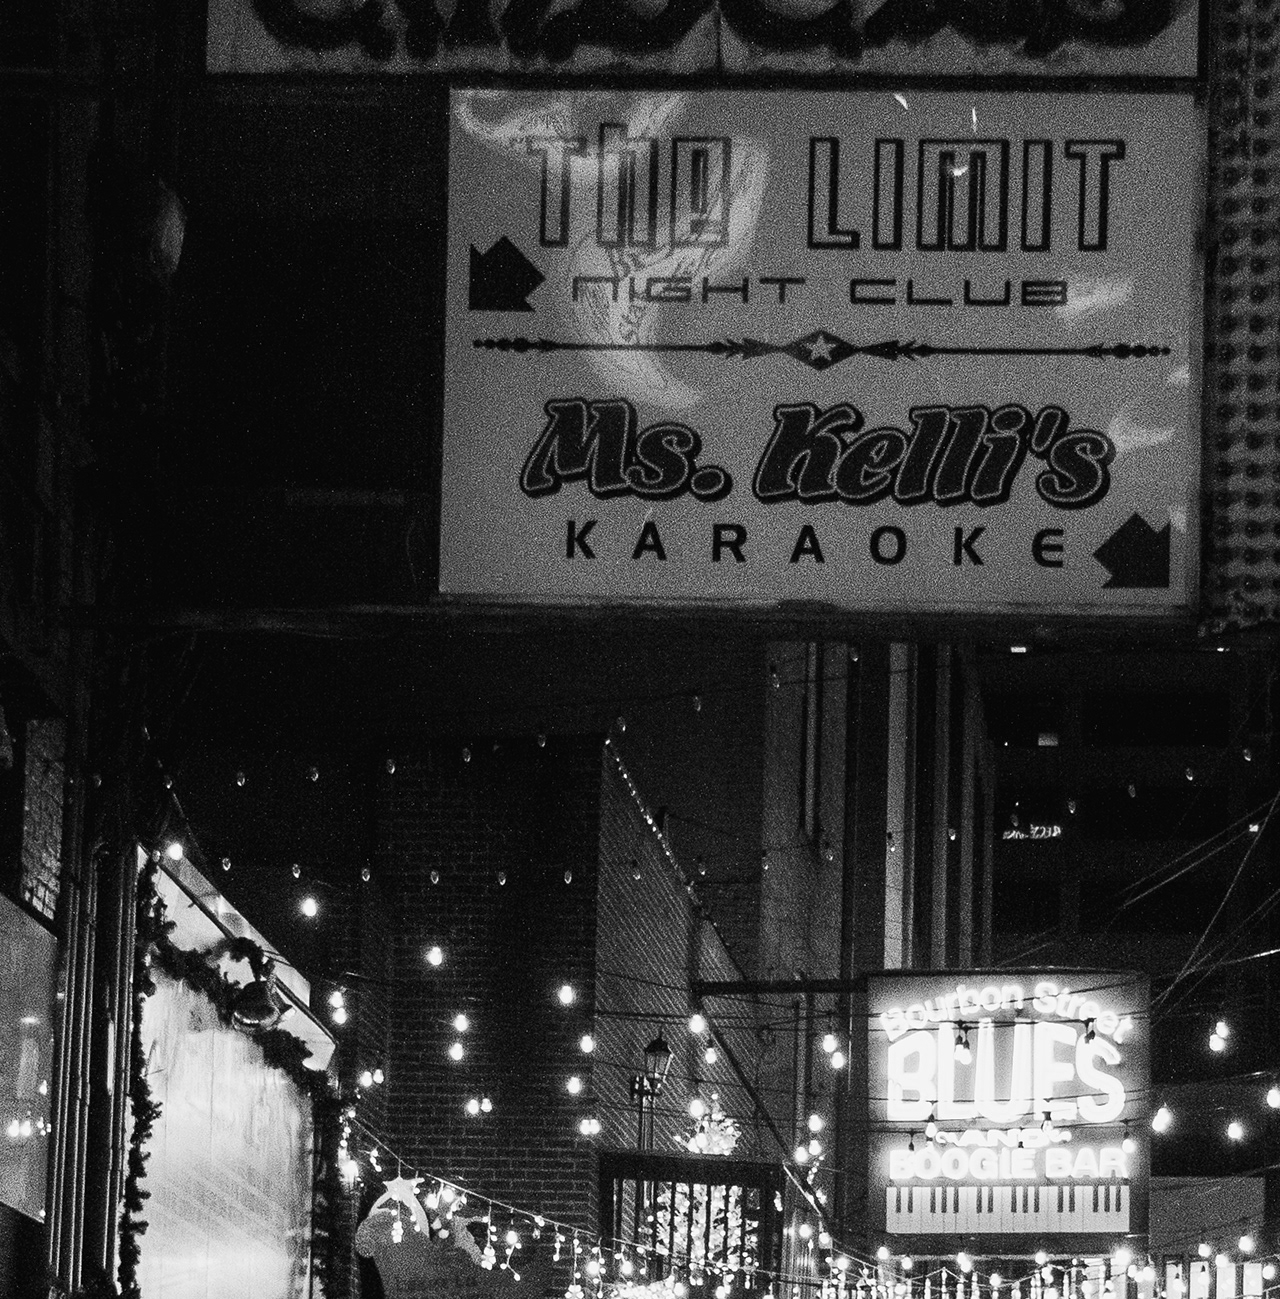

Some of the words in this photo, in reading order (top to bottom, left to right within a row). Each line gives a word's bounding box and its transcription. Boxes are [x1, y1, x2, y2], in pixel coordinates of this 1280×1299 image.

[807, 137, 1126, 250] LIMIT
[849, 278, 1068, 307] CLUB
[520, 400, 733, 501] Ms.
[752, 403, 1118, 509] Kelli's
[566, 520, 1067, 568] KARAOKE
[880, 985, 1023, 1041] Bourbon
[887, 1018, 1126, 1123] BLUES
[889, 1149, 1036, 1179] BOOGIE
[1046, 1148, 1129, 1179] BAR
